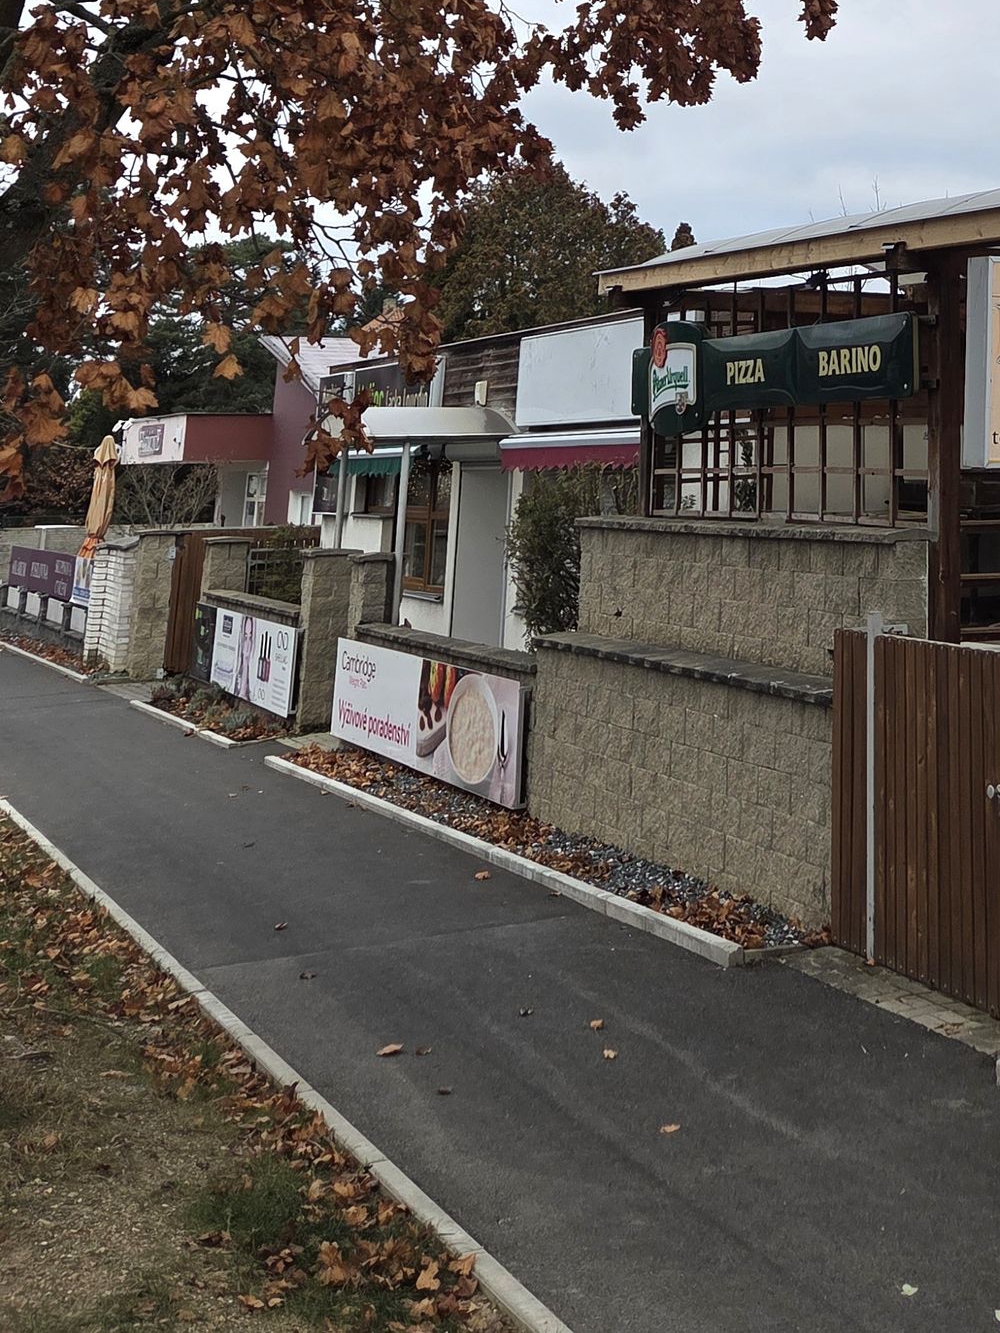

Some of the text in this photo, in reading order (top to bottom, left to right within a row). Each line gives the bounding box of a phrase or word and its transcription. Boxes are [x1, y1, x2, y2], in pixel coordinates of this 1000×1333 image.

[726, 345, 881, 385] PIZZA BARINO
[341, 650, 376, 682] Cambridge
[338, 698, 411, 748] Výživové poradenství
